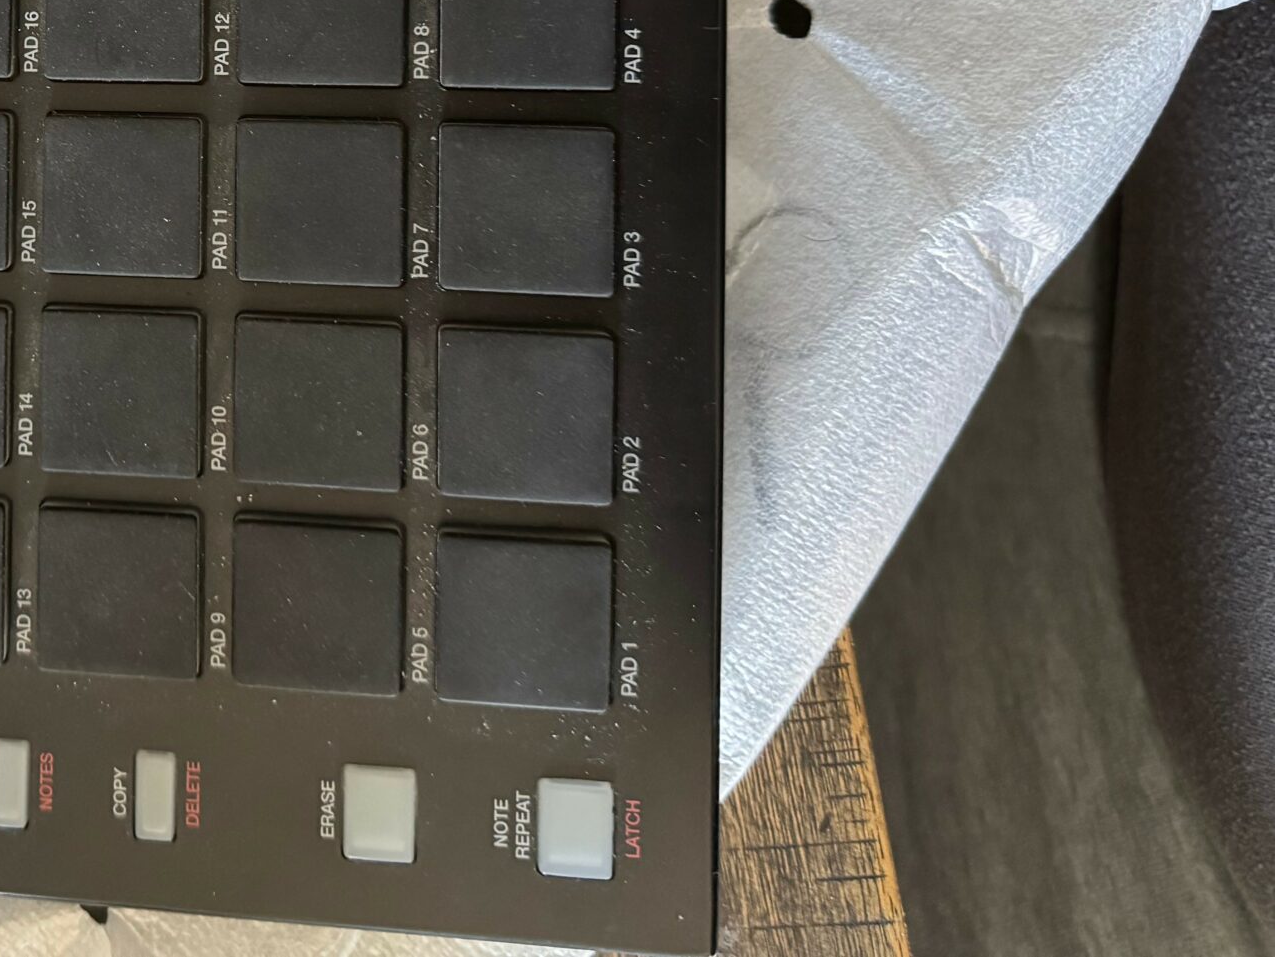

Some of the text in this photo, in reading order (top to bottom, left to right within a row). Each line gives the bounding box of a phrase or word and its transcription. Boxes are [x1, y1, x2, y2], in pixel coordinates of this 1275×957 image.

[24, 11, 40, 73] PAD 16
[215, 13, 230, 76] PAD 12
[414, 25, 430, 80] PAD 8
[624, 28, 642, 84] PAD 4
[21, 200, 37, 264] PAD 15
[212, 209, 227, 270] PAD 11
[413, 223, 429, 278] PAD 7
[624, 231, 641, 288] PAD 3
[18, 393, 33, 456] PAD 14
[211, 406, 226, 471] PAD 10
[413, 423, 428, 480] PAD 6
[623, 437, 640, 493] PAD 2
[16, 589, 32, 653] PAD 13
[210, 612, 226, 668] PAD 9
[413, 627, 428, 682] PAD 5
[622, 643, 638, 699] PAD 1
[40, 752, 53, 811] NOTES
[113, 766, 127, 817] COPY
[185, 761, 200, 828] DELETE
[321, 780, 335, 838] ERASE
[494, 798, 509, 847] NOTE
[515, 790, 531, 859] REPEAT
[625, 799, 641, 858] LATCH
